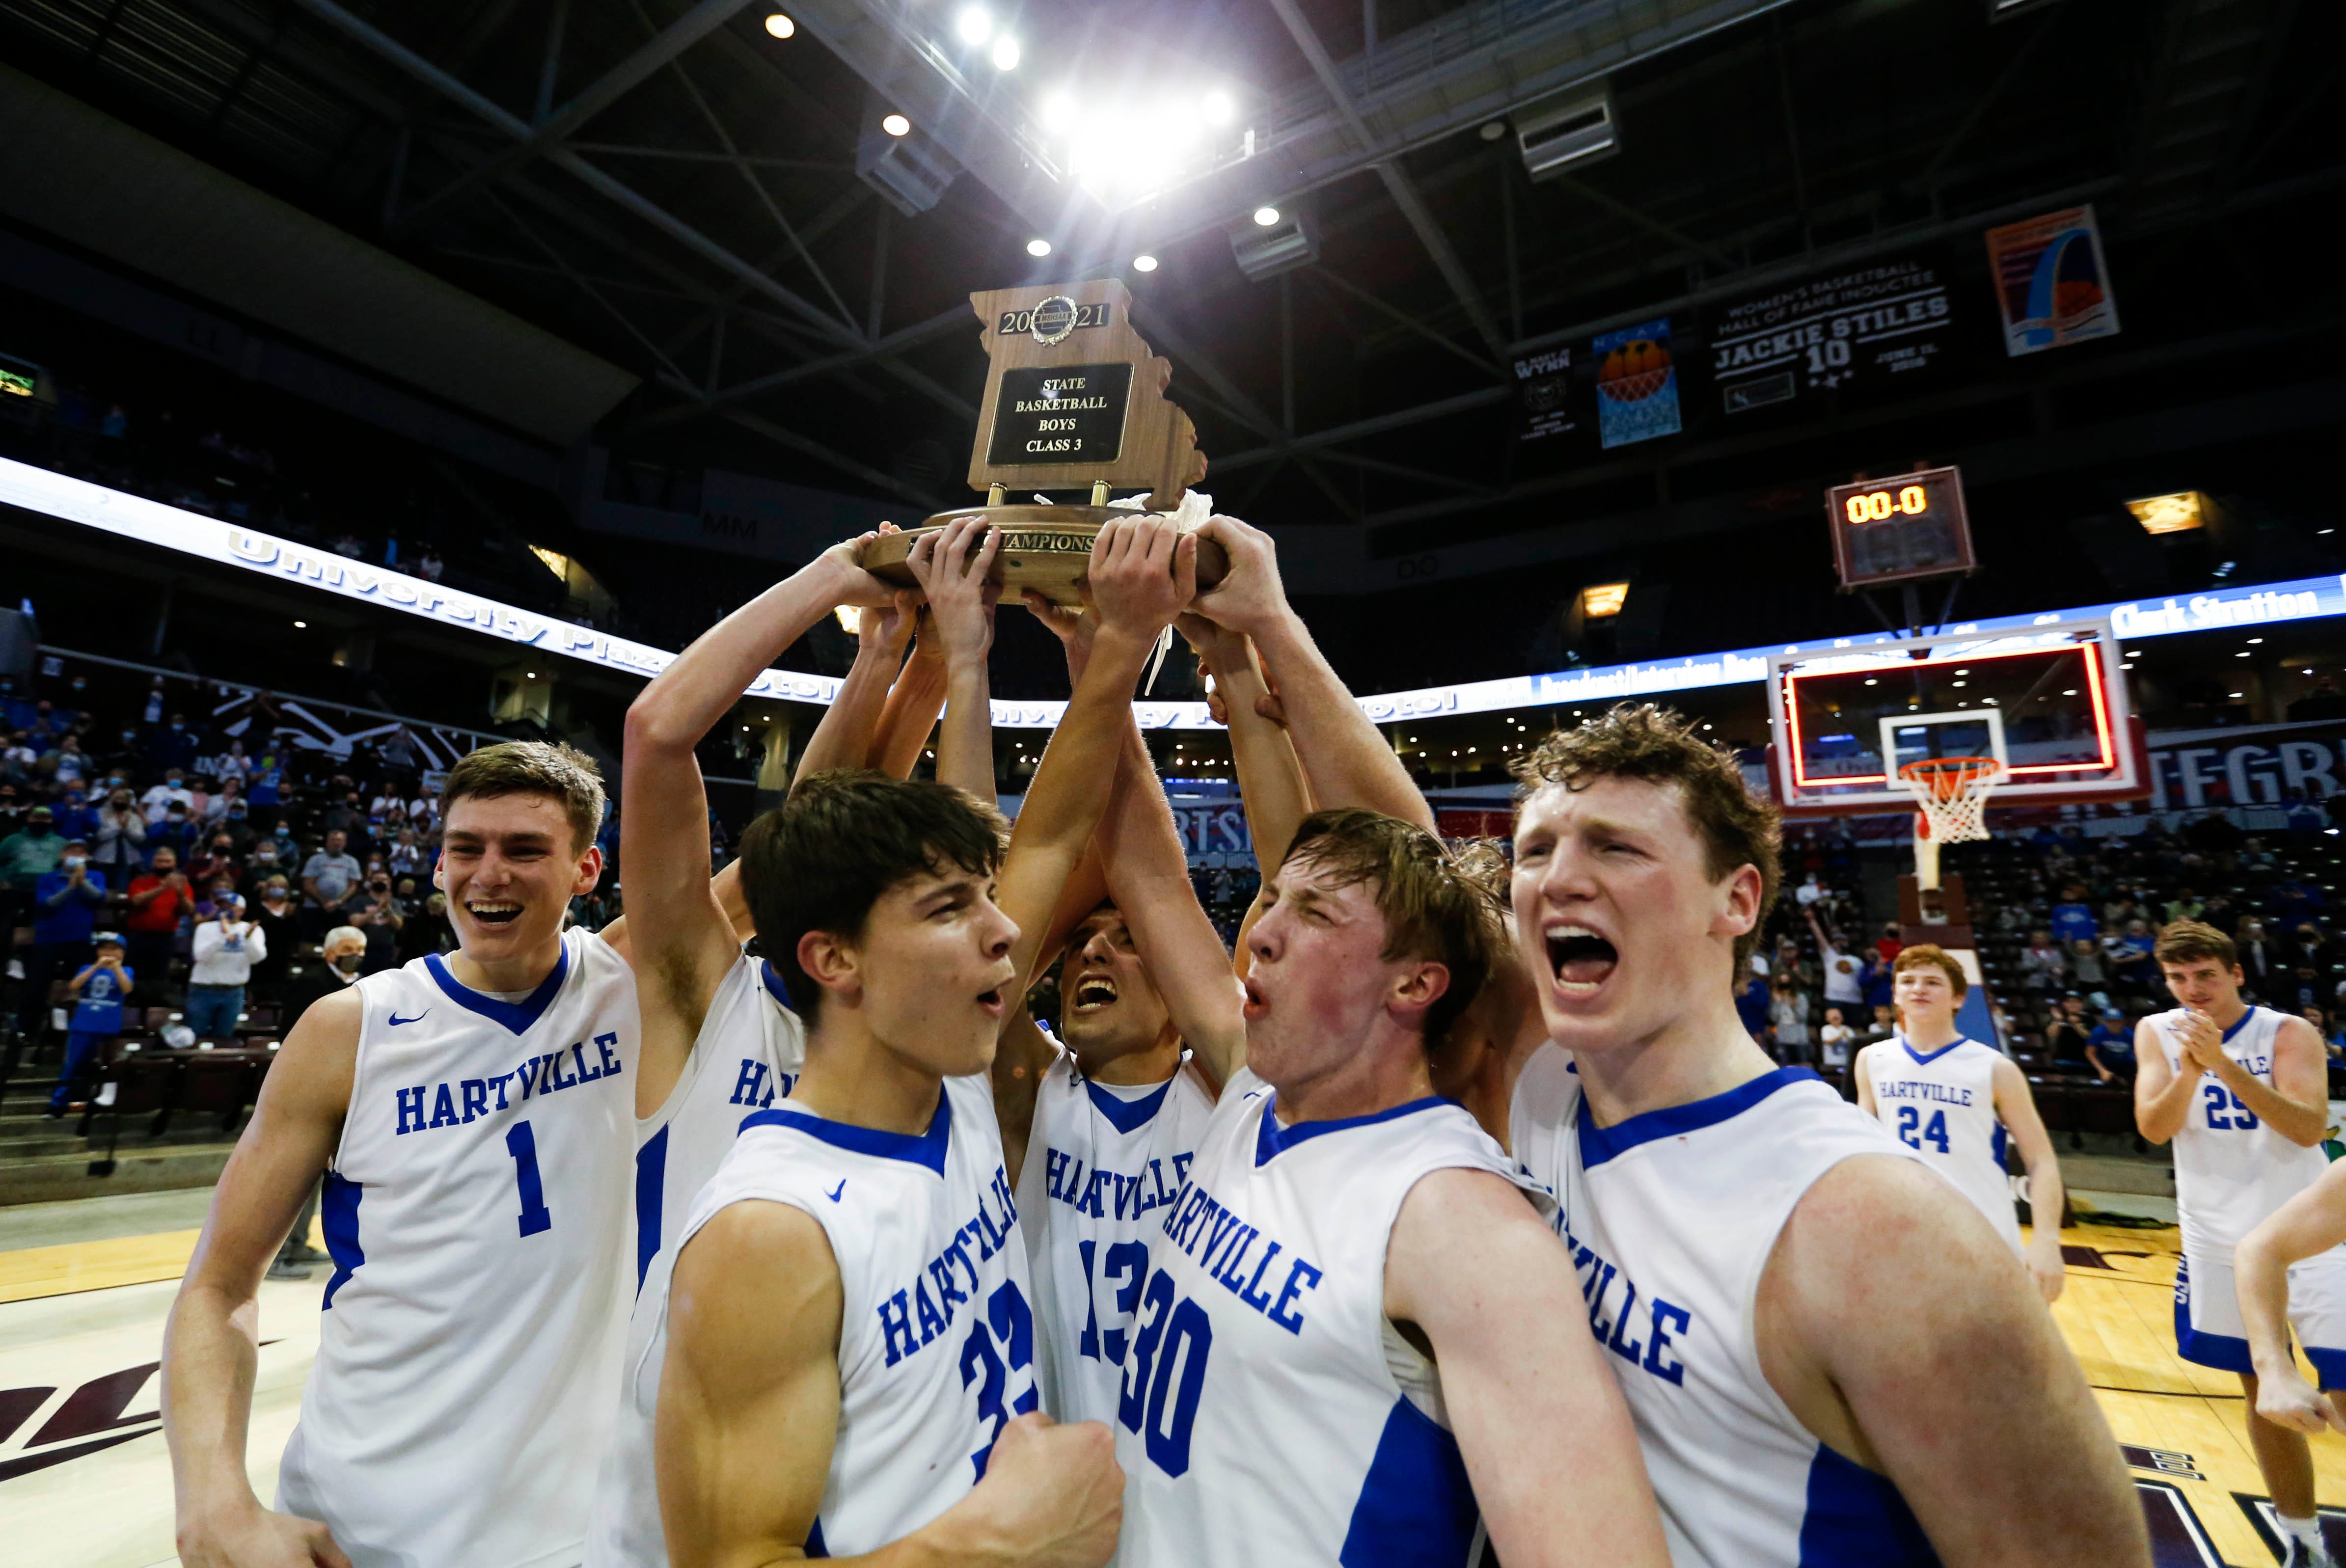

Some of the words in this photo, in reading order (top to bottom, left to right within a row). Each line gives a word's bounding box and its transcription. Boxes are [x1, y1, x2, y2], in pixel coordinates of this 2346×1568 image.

[1812, 261, 1919, 295] BASKETBALL
[1001, 311, 1030, 333] 20
[1041, 313, 1066, 322] MSHSAA
[1076, 304, 1104, 326] 21
[1714, 322, 1827, 369] JACKIE
[1830, 295, 1950, 339] STILES
[1764, 306, 1788, 324] OF
[1805, 339, 1853, 374] 10
[1043, 377, 1086, 391] STATE
[1015, 396, 1107, 412] BASKETBALL
[1038, 417, 1076, 432] BOYS
[1026, 439, 1070, 453] CLASS
[1073, 438, 1082, 451] 3
[984, 533, 1095, 551] AMPIONS
[226, 530, 547, 644] University
[1365, 690, 1458, 718] otel
[395, 1031, 622, 1135] HARTVILLE
[1879, 1081, 1973, 1108] HARTVILLE
[1898, 1106, 1950, 1154] 24
[505, 1119, 552, 1239] 1
[1162, 1180, 1323, 1336] ARTVILLE
[1079, 1239, 1149, 1367] 13
[1118, 1268, 1213, 1479] 30
